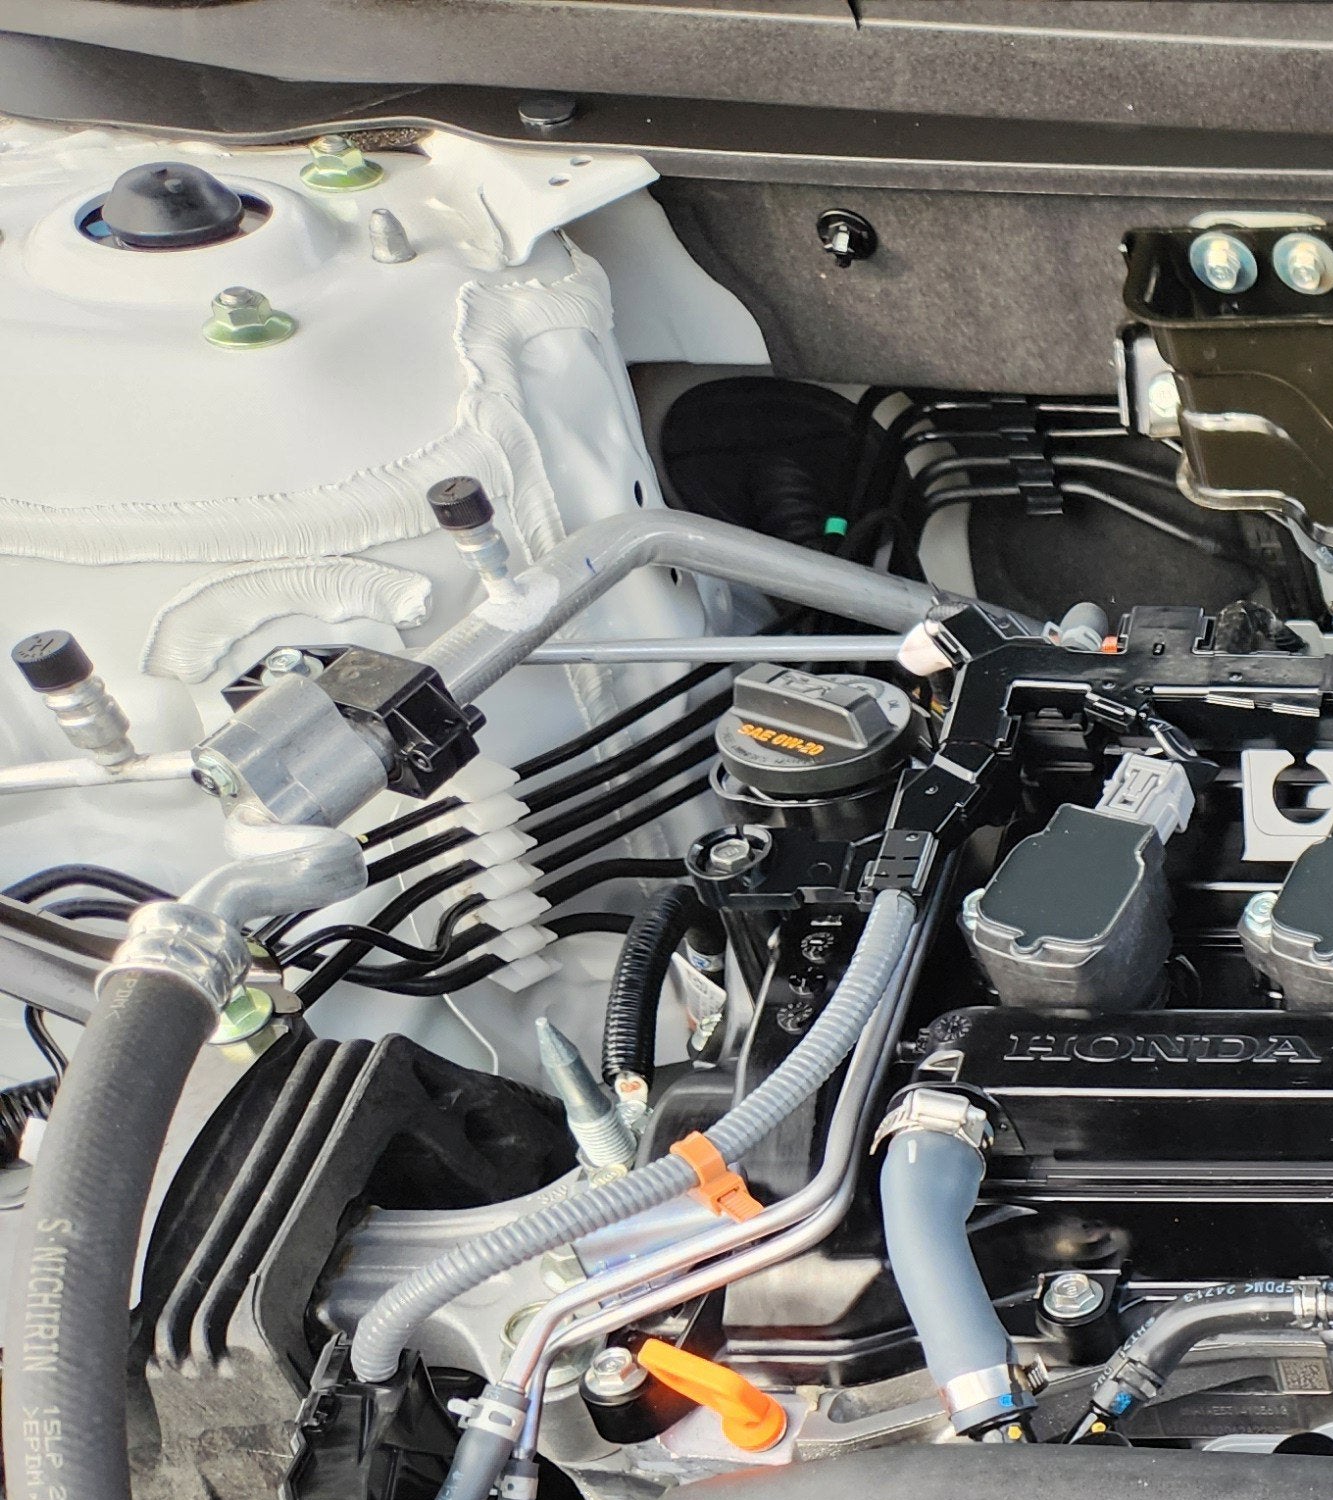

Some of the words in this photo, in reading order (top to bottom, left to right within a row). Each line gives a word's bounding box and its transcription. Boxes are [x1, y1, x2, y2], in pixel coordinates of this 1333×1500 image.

[737, 723, 776, 741] SAE
[771, 732, 825, 756] 0W-20
[1003, 1034, 1322, 1063] HONDA
